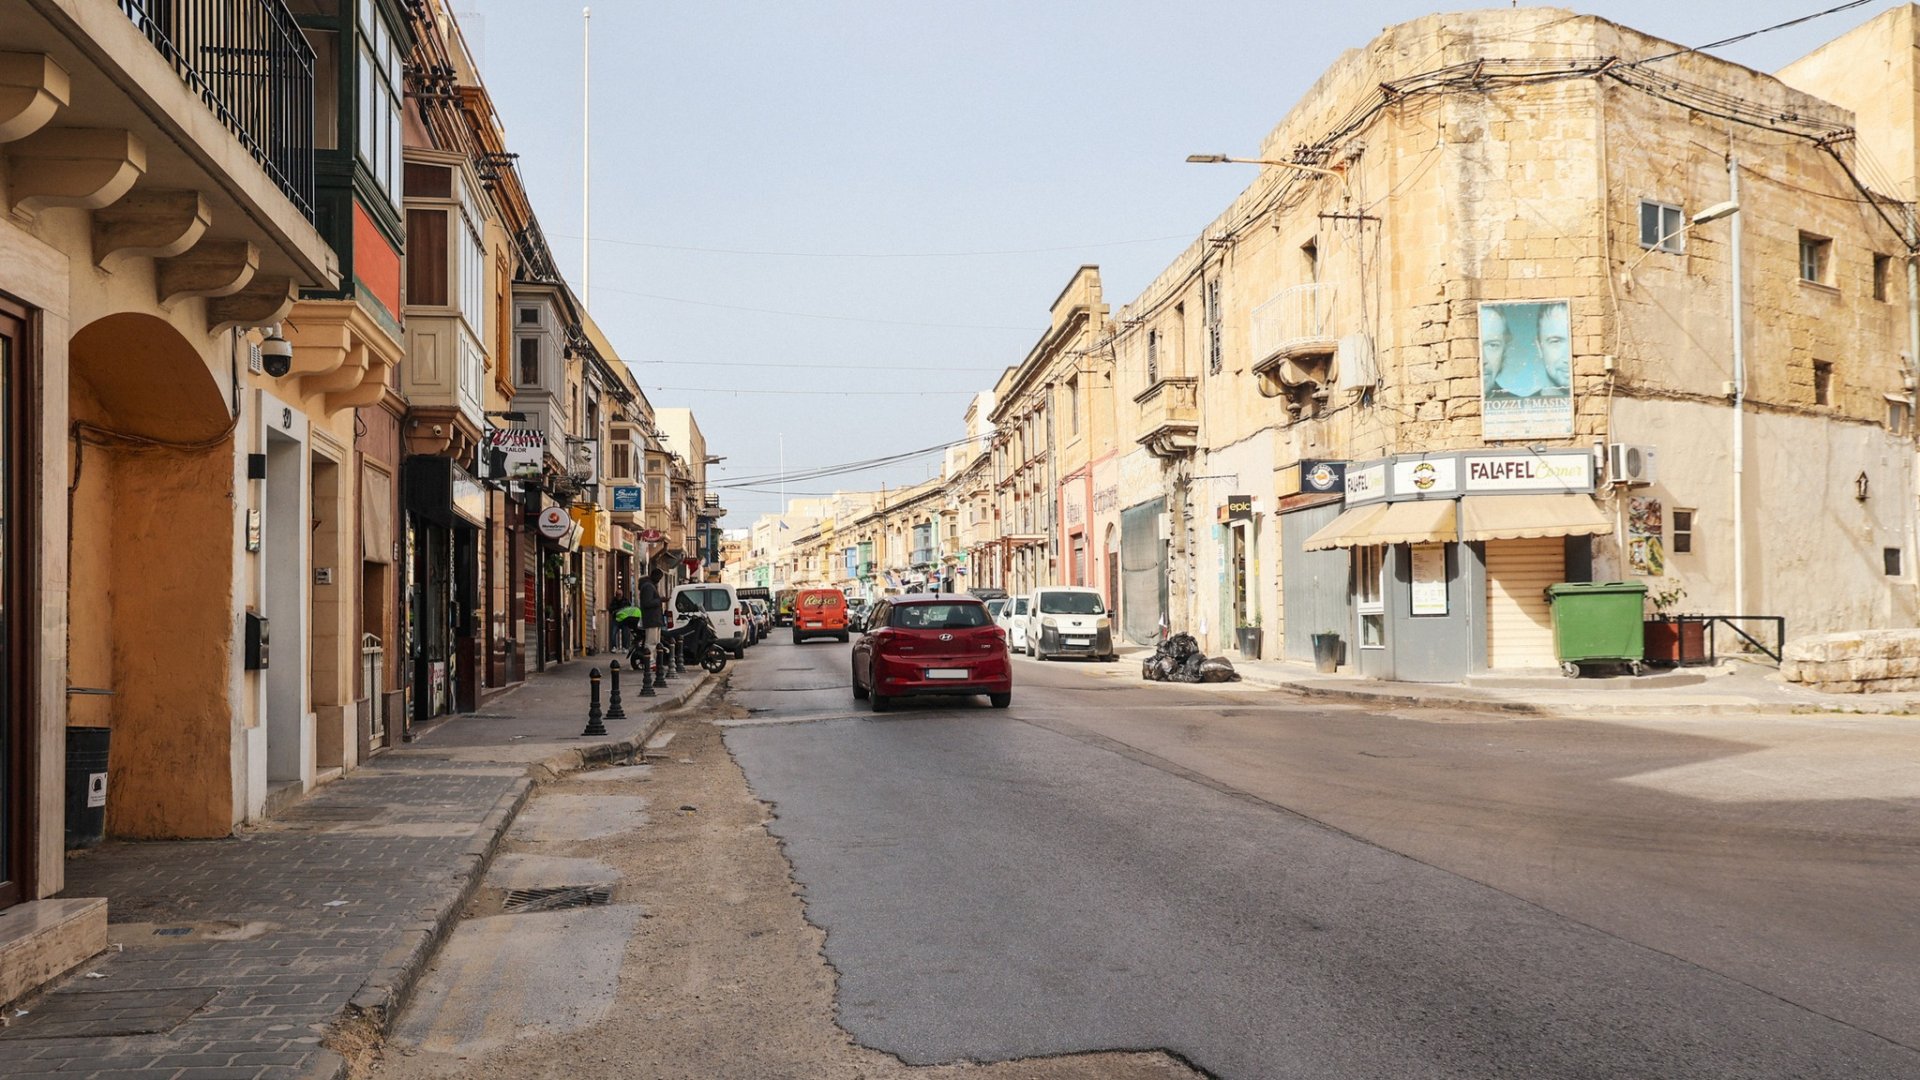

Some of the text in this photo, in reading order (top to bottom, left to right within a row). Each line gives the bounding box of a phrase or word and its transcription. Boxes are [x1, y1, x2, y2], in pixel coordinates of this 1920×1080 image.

[1485, 400, 1522, 410] TOZZI
[1471, 461, 1535, 480] FALAFEL
[1230, 501, 1251, 512] epic
